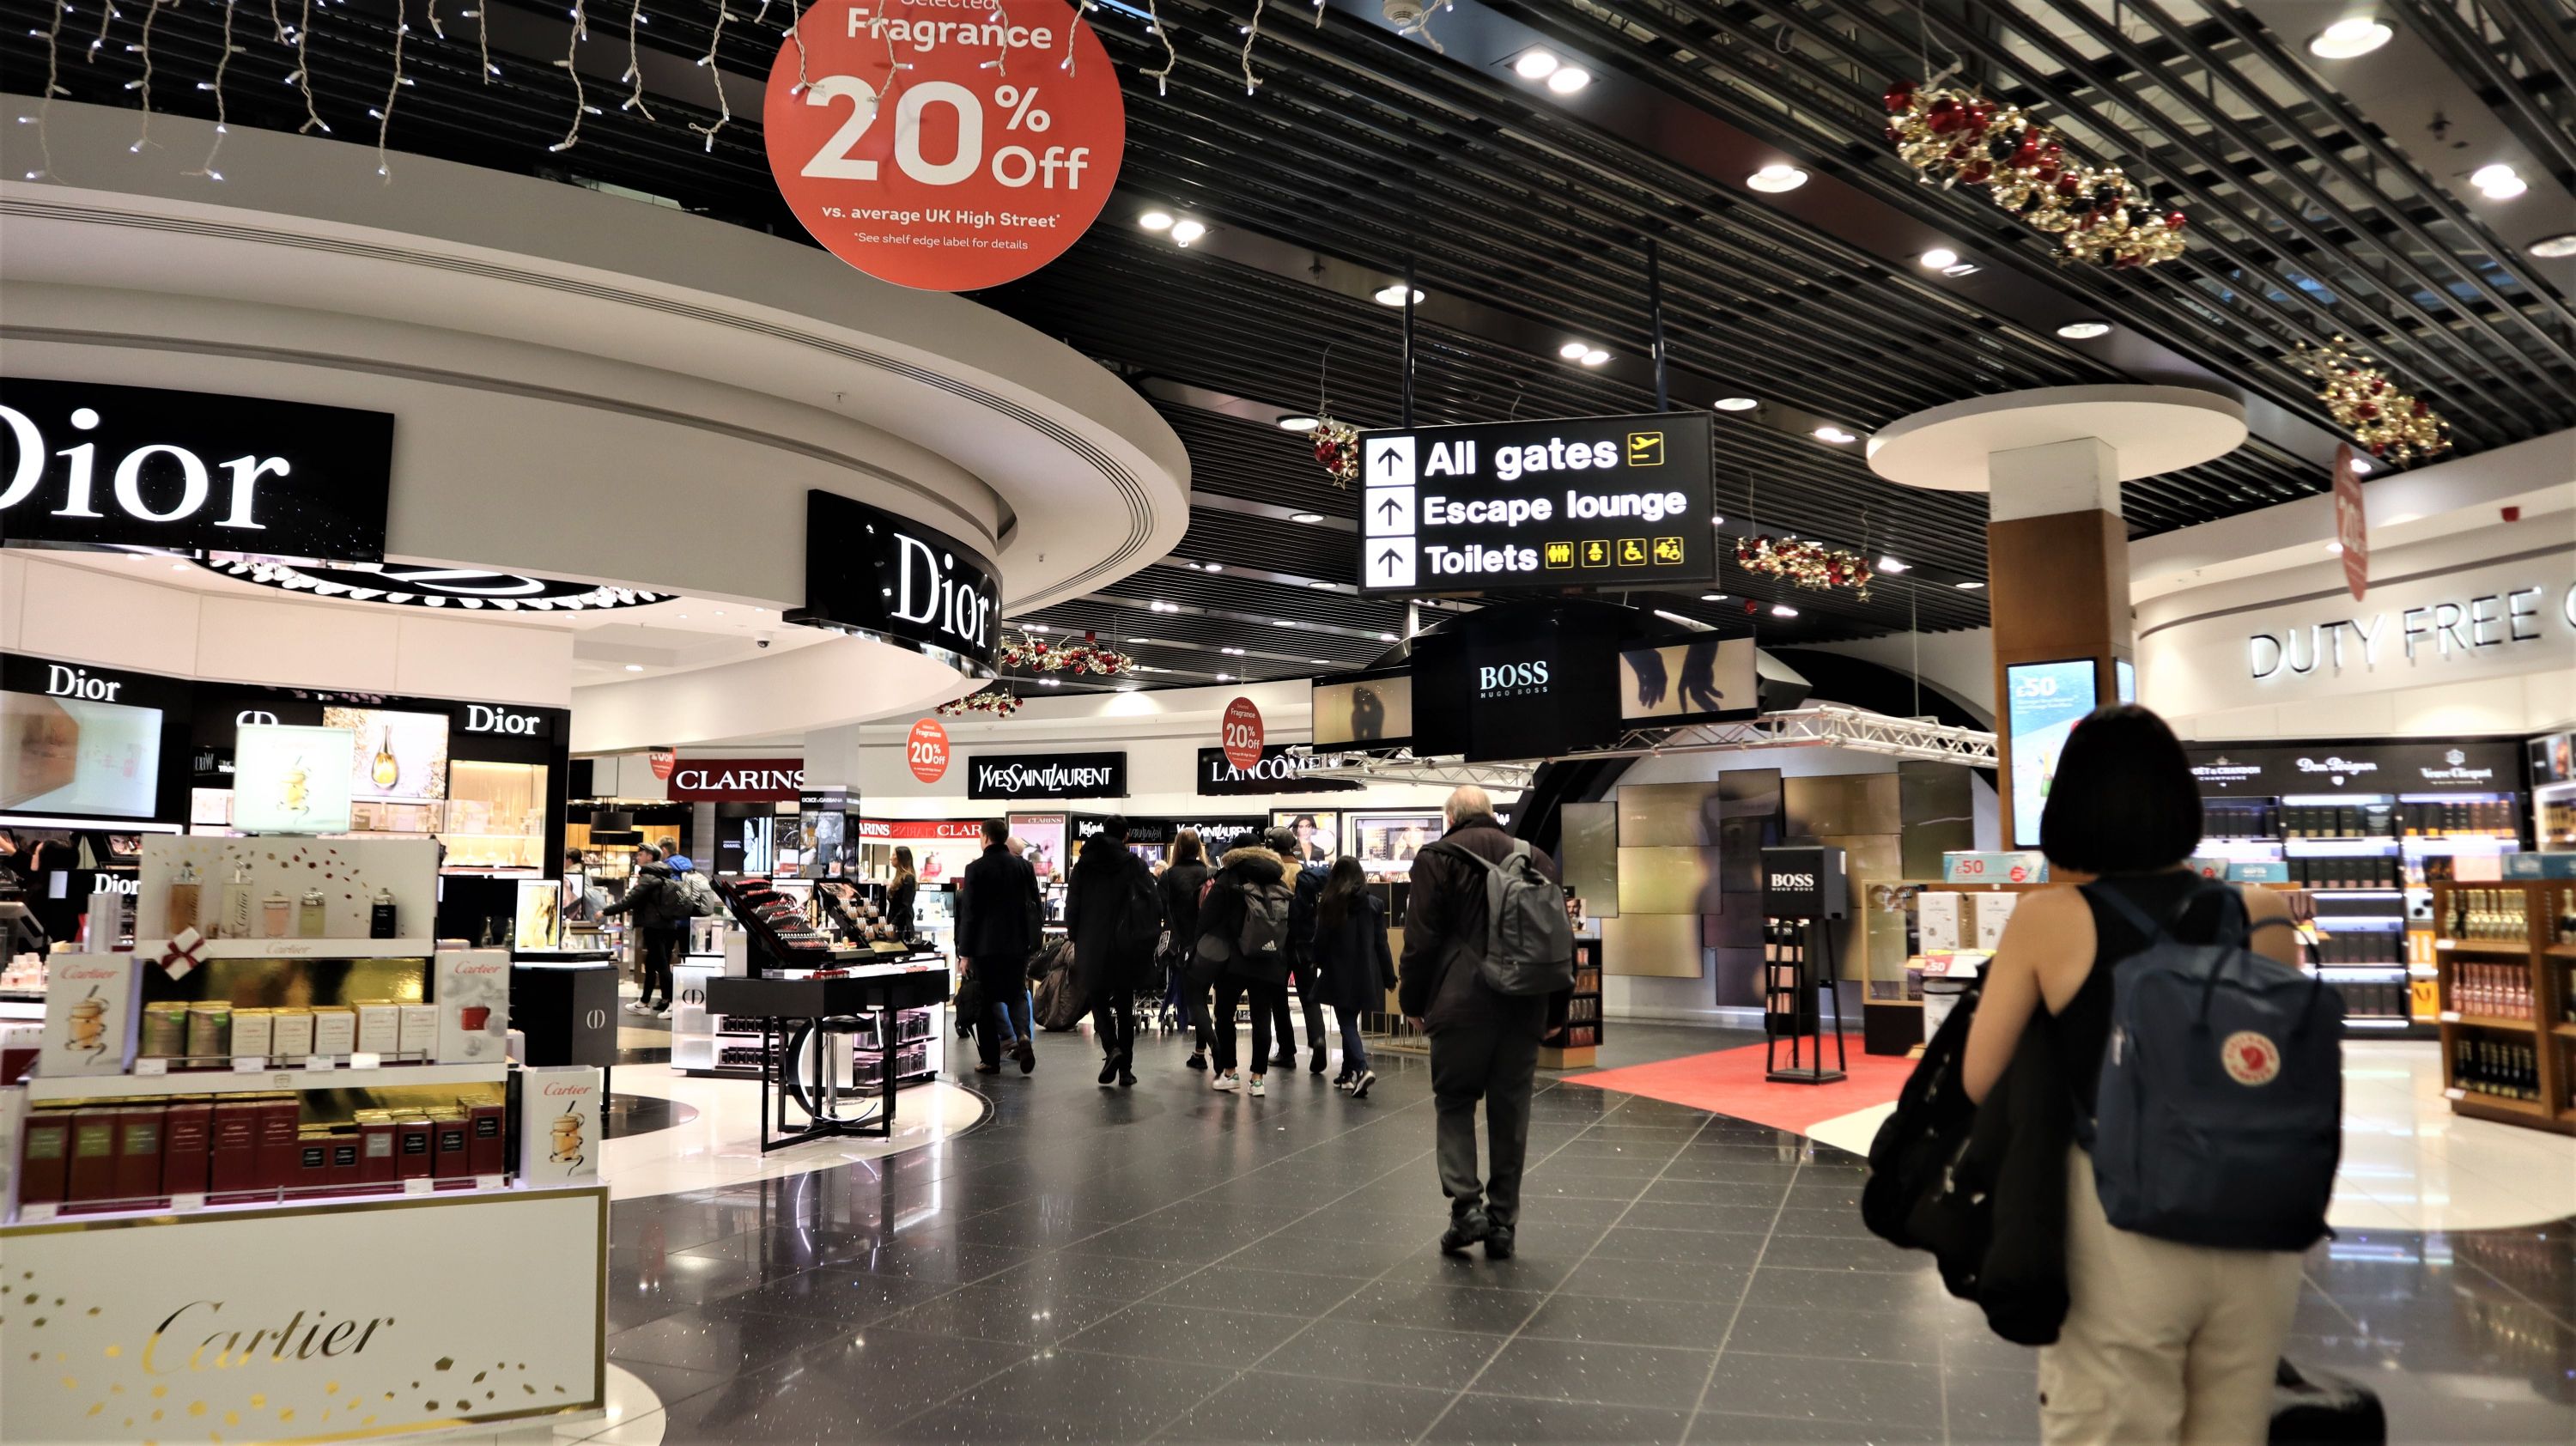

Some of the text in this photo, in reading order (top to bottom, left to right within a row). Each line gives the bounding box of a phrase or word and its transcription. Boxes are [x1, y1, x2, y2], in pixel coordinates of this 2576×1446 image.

[848, 8, 1053, 52] Fragrance
[991, 145, 1091, 191] Off
[821, 205, 847, 218] vs.
[851, 207, 920, 226] average
[925, 209, 951, 224] UK
[955, 210, 996, 229] High
[882, 233, 912, 246] shelf
[913, 236, 940, 249] edge
[943, 236, 970, 248] label
[971, 237, 989, 249] for
[991, 238, 1030, 251] details
[1424, 436, 1619, 482] All gates
[1424, 489, 1688, 527] Escape lounge
[1424, 543, 1539, 575] Toilets
[890, 532, 990, 649] Dior
[2249, 613, 2387, 680] DUTY
[2403, 586, 2543, 660] FREE
[46, 664, 121, 703] Dior
[1479, 660, 1549, 690] BOSS
[1480, 686, 1548, 699] HUGO BOSS
[464, 704, 541, 735] Dior
[1230, 708, 1256, 719] Fragrance
[1248, 738, 1261, 750] Off
[933, 755, 946, 765] Off
[675, 769, 805, 791] CLARINS
[93, 872, 141, 895] Dior
[1771, 873, 1814, 887] BOSS
[264, 942, 312, 956] Cartier
[60, 963, 119, 981] Cartier
[454, 960, 502, 975] Cartier
[543, 1081, 592, 1097] Cartier
[141, 1299, 396, 1376] Cartier
